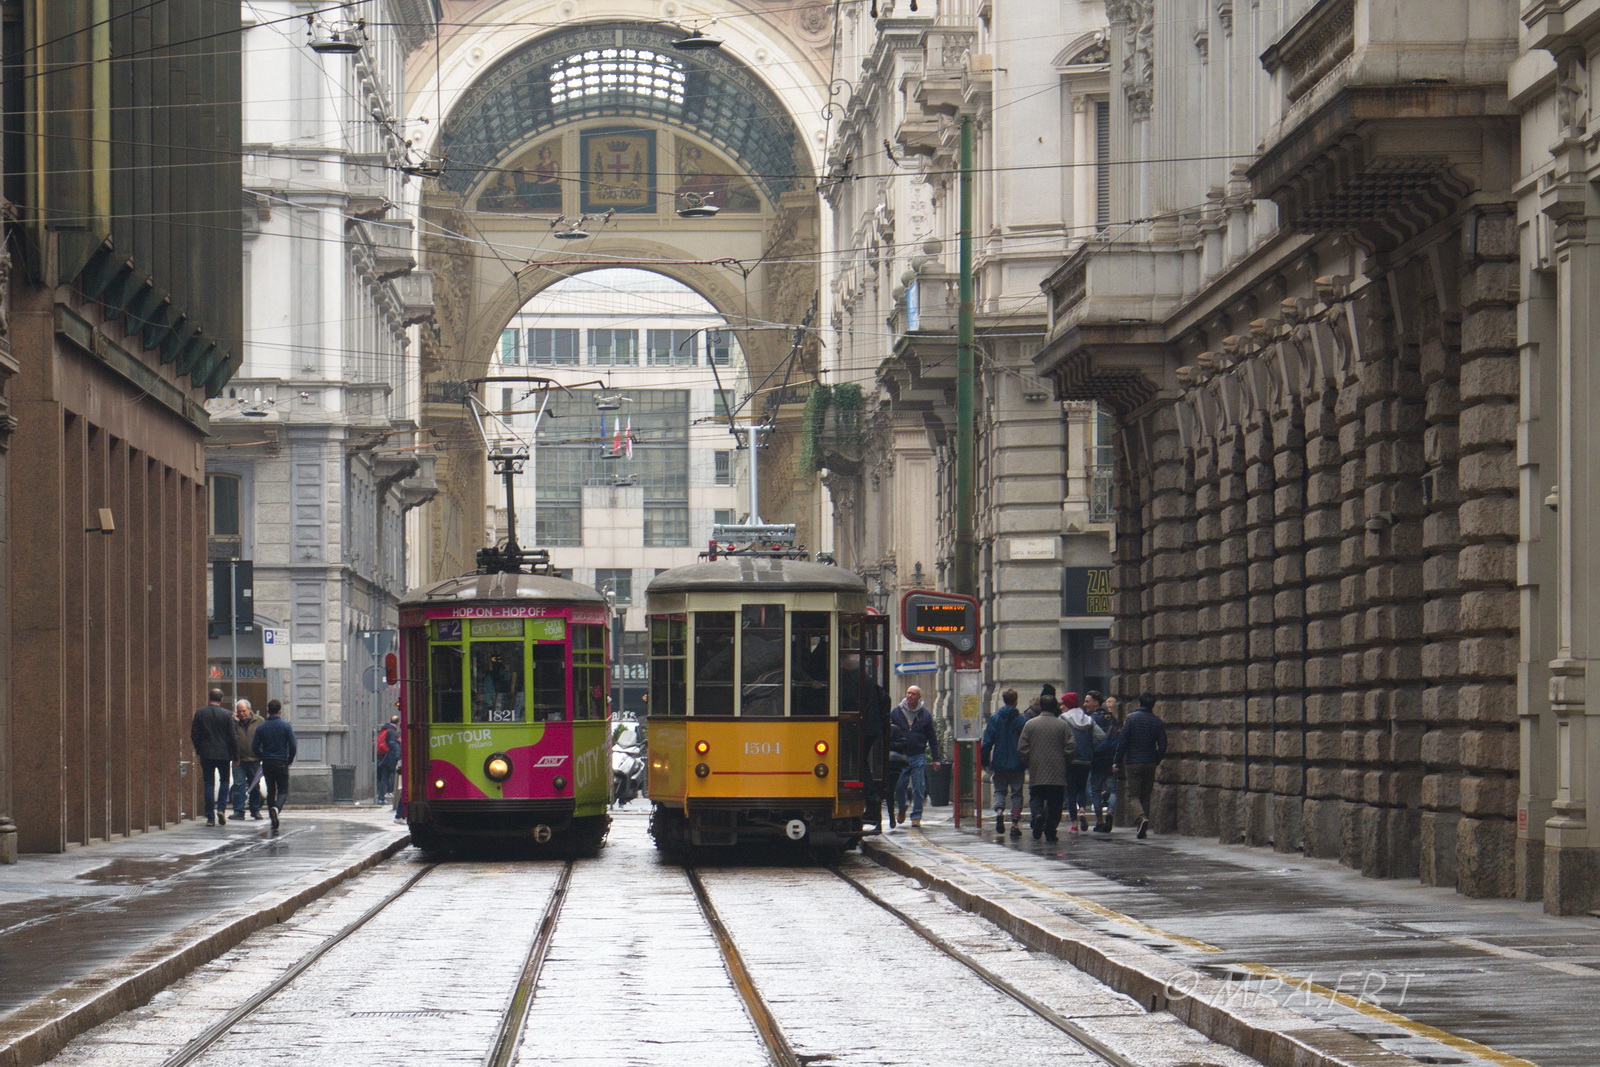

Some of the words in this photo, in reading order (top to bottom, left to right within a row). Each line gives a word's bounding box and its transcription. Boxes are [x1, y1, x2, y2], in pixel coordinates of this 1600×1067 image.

[452, 607, 473, 617] HOP
[476, 607, 493, 617] ON
[502, 607, 526, 617] HOP
[528, 606, 546, 616] OFF
[452, 620, 461, 636] 2
[471, 623, 494, 635] CITY
[495, 619, 523, 631] TOUR
[546, 619, 561, 628] CITY
[544, 626, 563, 635] TOUR
[488, 709, 515, 721] 1821
[430, 733, 454, 748] CITY
[456, 728, 492, 743] TOUR
[469, 741, 493, 749] milano
[744, 742, 782, 755] 1504
[576, 746, 600, 788] CITY
